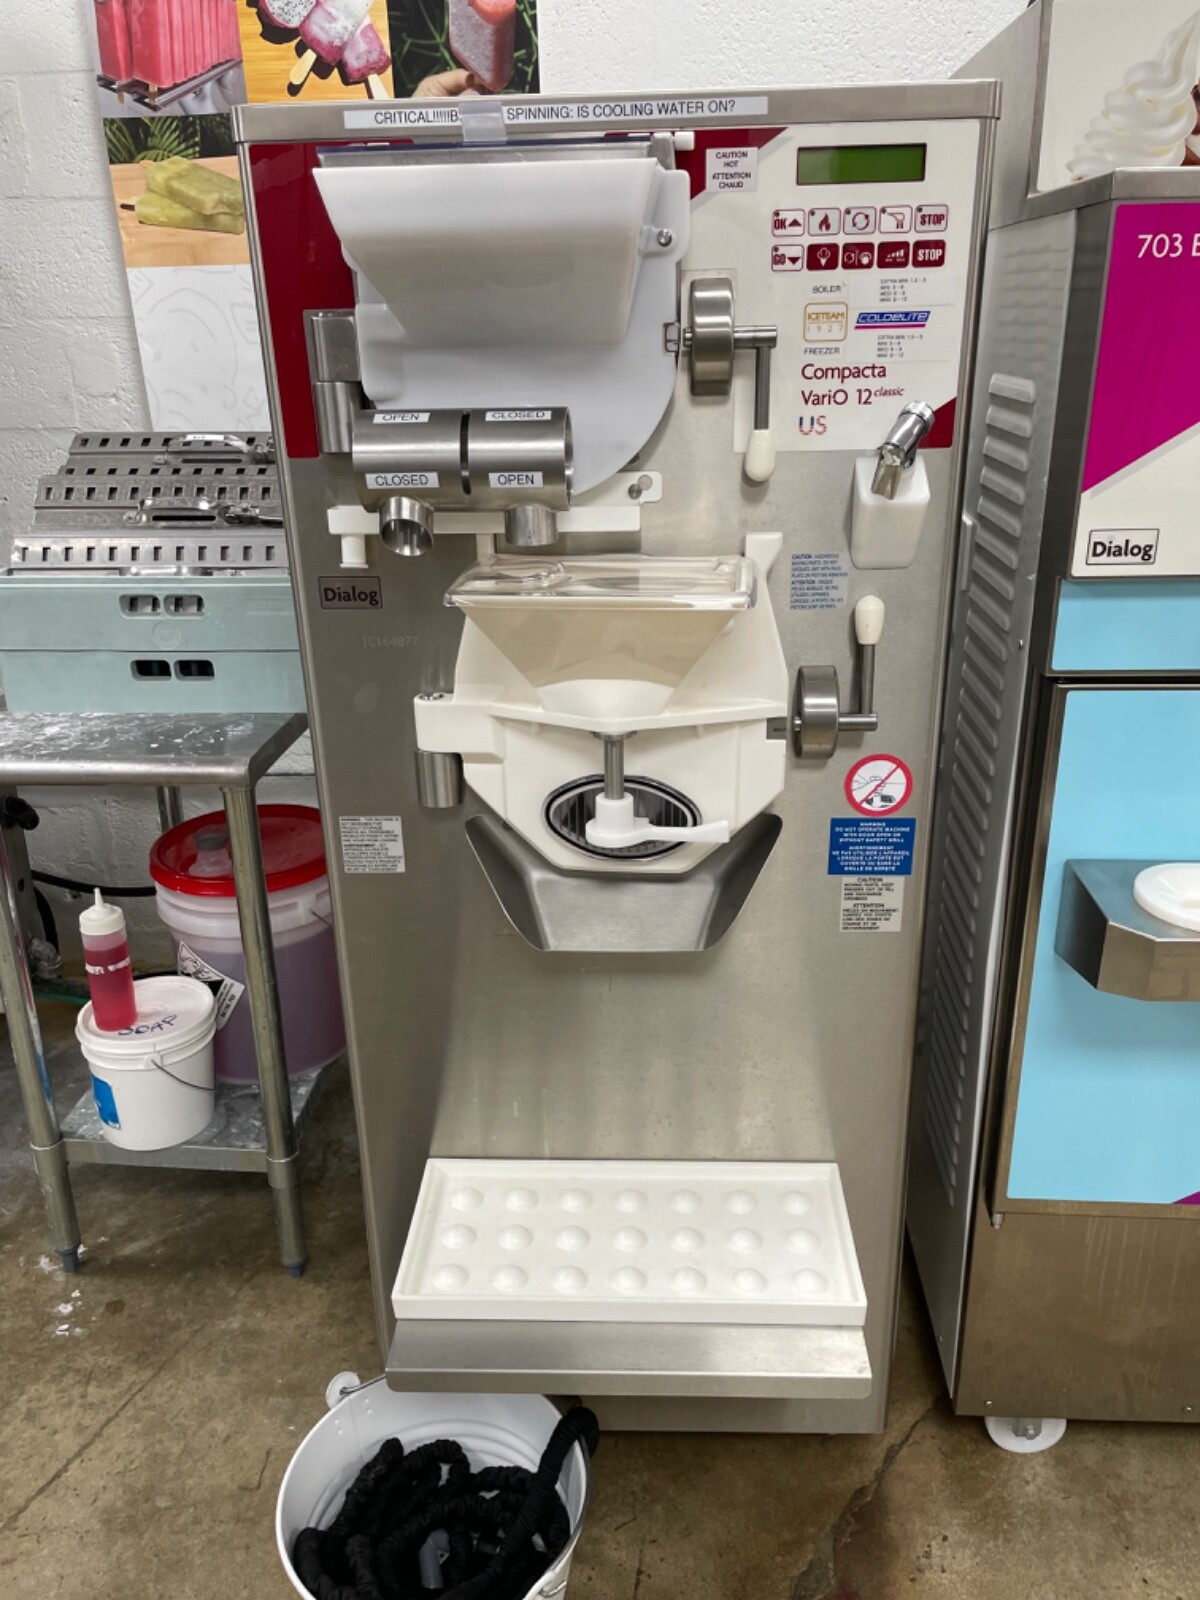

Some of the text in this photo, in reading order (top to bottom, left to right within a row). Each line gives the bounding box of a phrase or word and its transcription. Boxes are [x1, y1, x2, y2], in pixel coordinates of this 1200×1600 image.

[507, 105, 573, 121] SPINNING:
[577, 104, 590, 119] IS
[593, 102, 653, 118] COOLING
[656, 100, 705, 116] WATER
[708, 99, 736, 114] ON?
[715, 151, 748, 159] CAUTION
[724, 160, 738, 168] HOT
[712, 171, 752, 180] ATTENTION
[774, 218, 786, 230] OK
[920, 213, 945, 226] STOP
[1137, 232, 1184, 258] 703
[917, 248, 943, 262] STOP
[812, 285, 842, 294] BOILER
[804, 347, 840, 355] FREEZER
[801, 362, 886, 384] Compacta
[801, 386, 904, 406] VariO 12 classic
[382, 413, 420, 422] OPEN
[492, 411, 546, 420] CLOSED
[798, 415, 828, 436] US
[375, 474, 429, 486] CLOSED
[498, 474, 534, 486] OPEN
[1092, 538, 1154, 561] Dialog
[324, 585, 379, 606] Dialog
